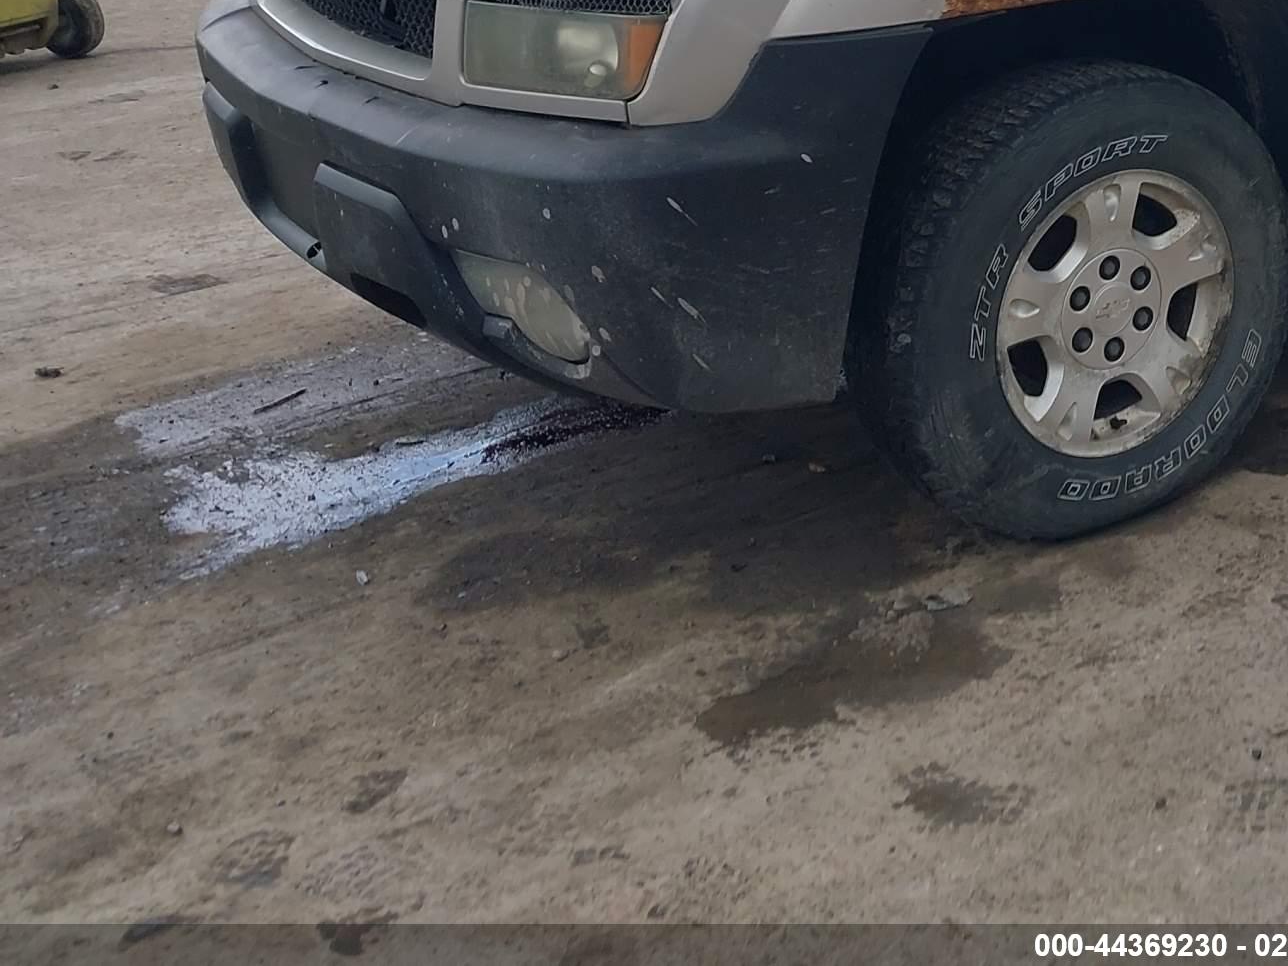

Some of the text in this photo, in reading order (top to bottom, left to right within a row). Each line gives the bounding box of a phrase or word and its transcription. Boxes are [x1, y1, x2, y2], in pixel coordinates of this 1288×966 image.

[969, 134, 1168, 362] ZTR SPORT
[1057, 328, 1263, 501] ELDORADO
